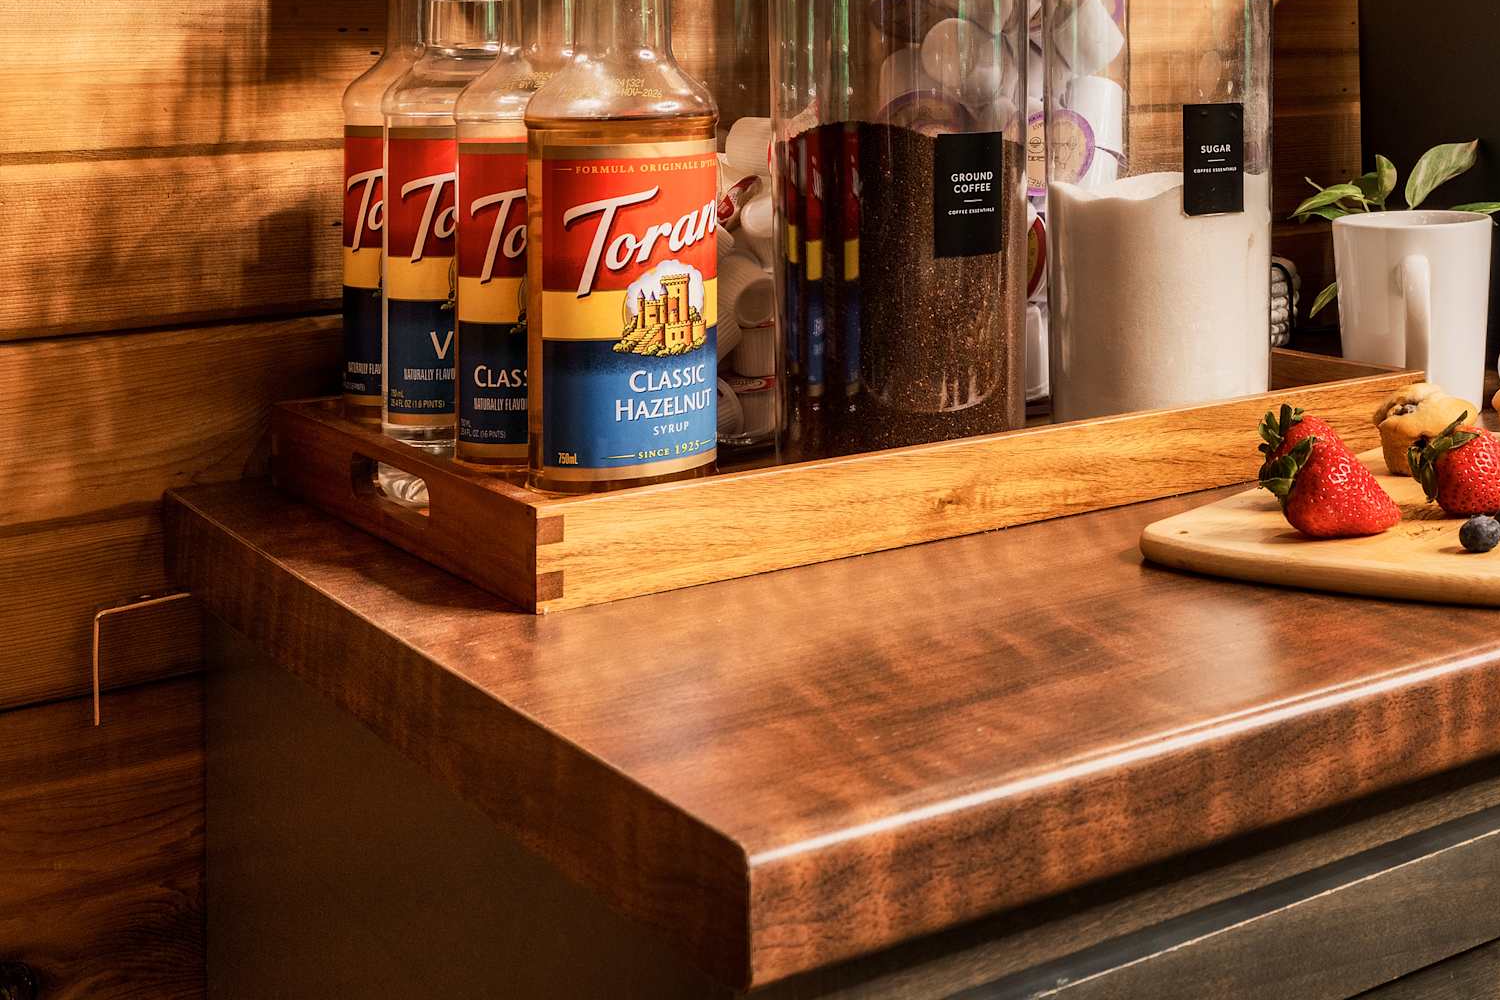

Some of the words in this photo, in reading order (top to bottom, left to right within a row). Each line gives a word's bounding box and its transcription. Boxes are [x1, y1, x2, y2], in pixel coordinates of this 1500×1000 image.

[1200, 143, 1231, 154] SUGAR
[575, 164, 635, 175] FORMULA
[640, 159, 700, 172] ORIGINALE
[950, 171, 993, 183] GROUND
[953, 182, 992, 194] COFFEE
[948, 208, 968, 216] COFFEE
[369, 363, 383, 375] FLAV
[403, 367, 435, 381] NATURALLY
[436, 367, 456, 380] FLAVO
[628, 364, 705, 393] CLASSIC
[473, 397, 504, 411] NATURALLY
[505, 398, 528, 412] FLAVO
[615, 388, 712, 422] HAZELNUT
[653, 421, 689, 436] SYRUP
[638, 448, 669, 460] SINCE
[675, 439, 700, 456] 1925
[558, 452, 578, 465] 750mL
